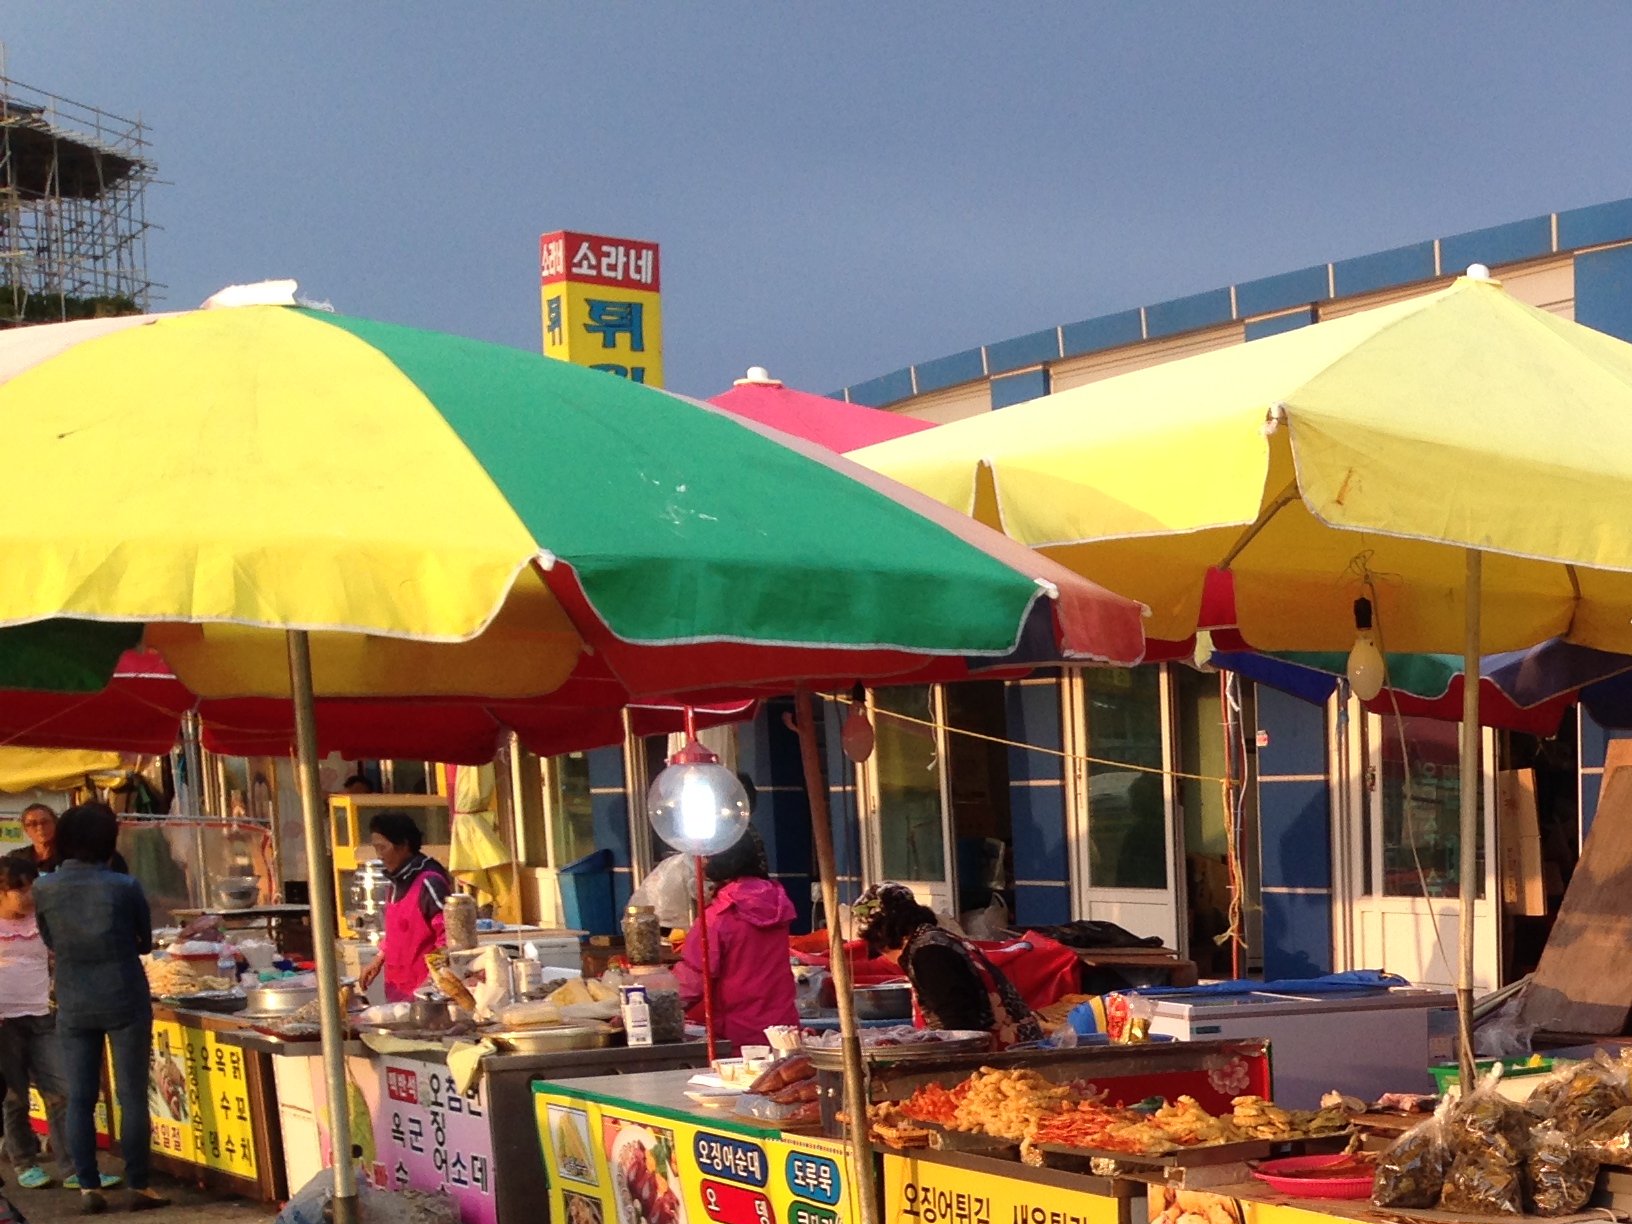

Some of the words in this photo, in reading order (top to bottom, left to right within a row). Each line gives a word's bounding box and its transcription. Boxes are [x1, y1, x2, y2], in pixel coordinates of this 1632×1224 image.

[541, 239, 564, 277] 소라네
[571, 242, 654, 284] 소라네
[698, 1139, 762, 1180] 오징어순대
[793, 1159, 832, 1198] 도루묵
